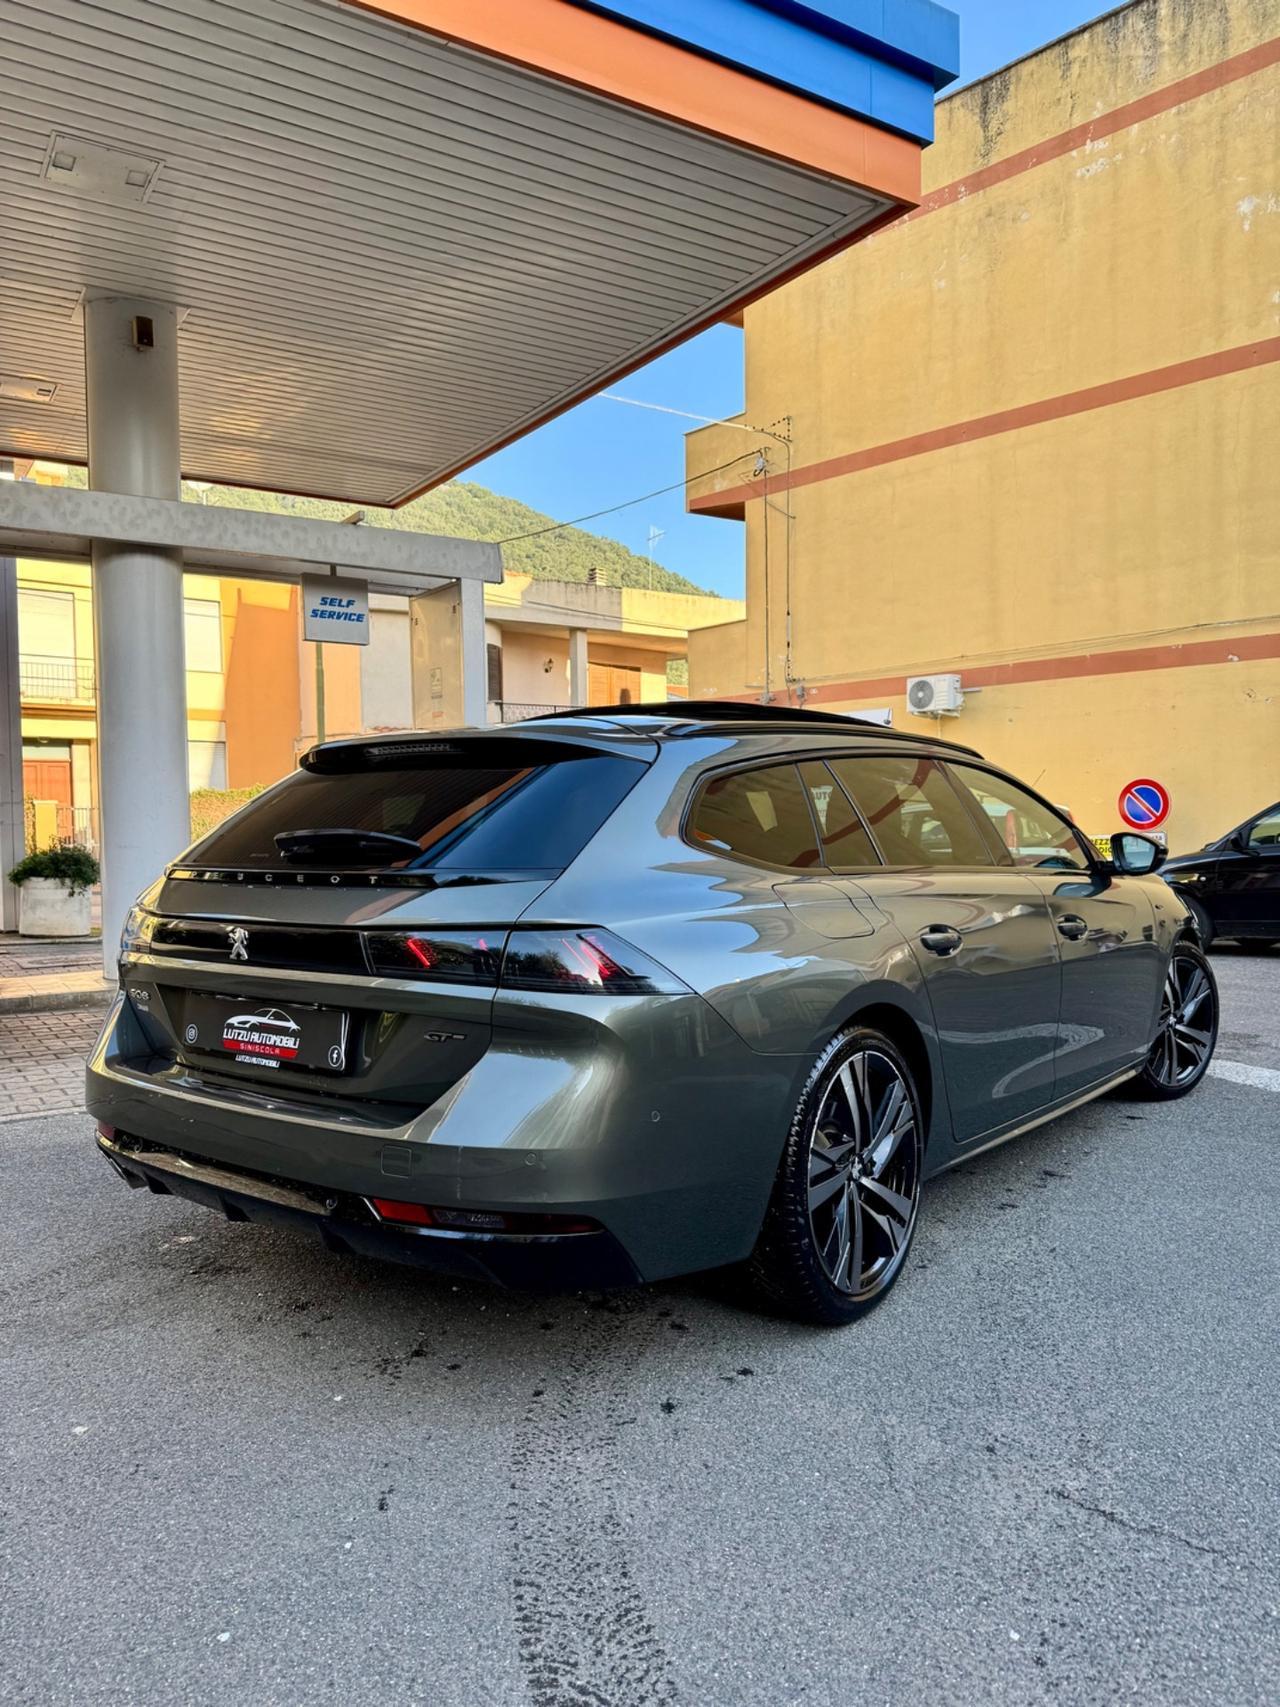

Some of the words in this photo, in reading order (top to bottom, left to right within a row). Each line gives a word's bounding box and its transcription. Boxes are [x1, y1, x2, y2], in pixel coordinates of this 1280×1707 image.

[320, 597, 355, 608] SELF
[310, 609, 365, 622] SERVICE
[191, 871, 378, 885] PEUGEOT
[223, 1028, 250, 1040] LUTZU
[250, 1032, 300, 1049] AUTOMOBILI
[240, 1043, 280, 1055] SINISCOLA
